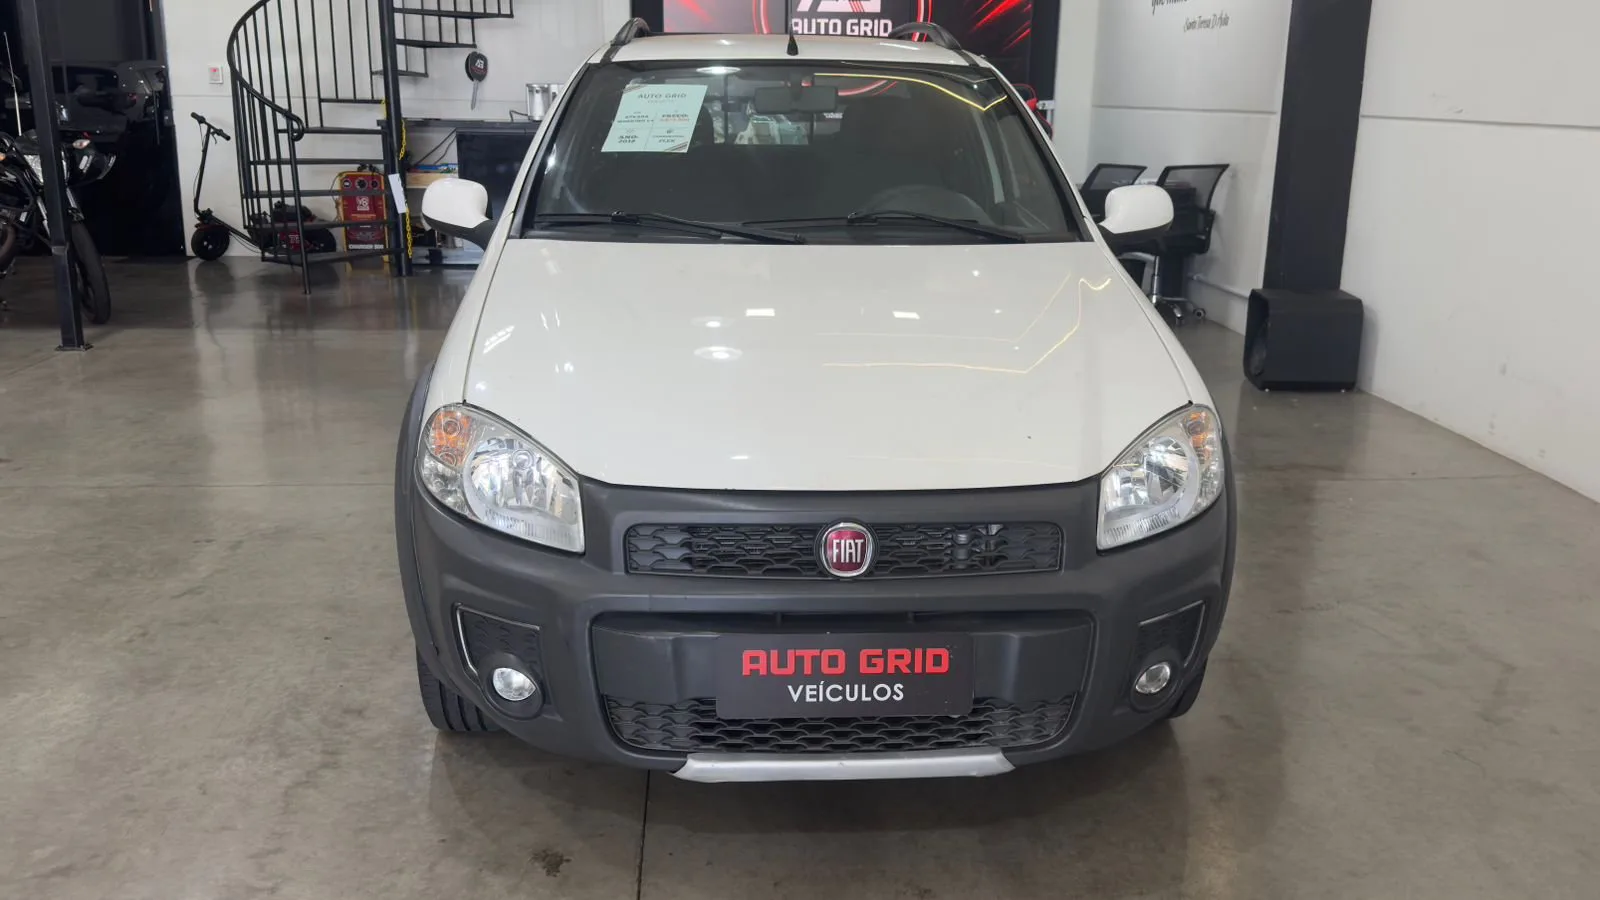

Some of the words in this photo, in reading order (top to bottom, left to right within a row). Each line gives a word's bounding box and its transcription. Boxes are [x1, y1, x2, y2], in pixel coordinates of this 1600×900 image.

[791, 18, 842, 35] AUTO
[846, 18, 893, 37] GRID
[832, 539, 864, 563] FIAT
[742, 648, 846, 676] AUTO
[859, 648, 949, 674] GRID
[788, 681, 905, 703] VEÍCULOS
